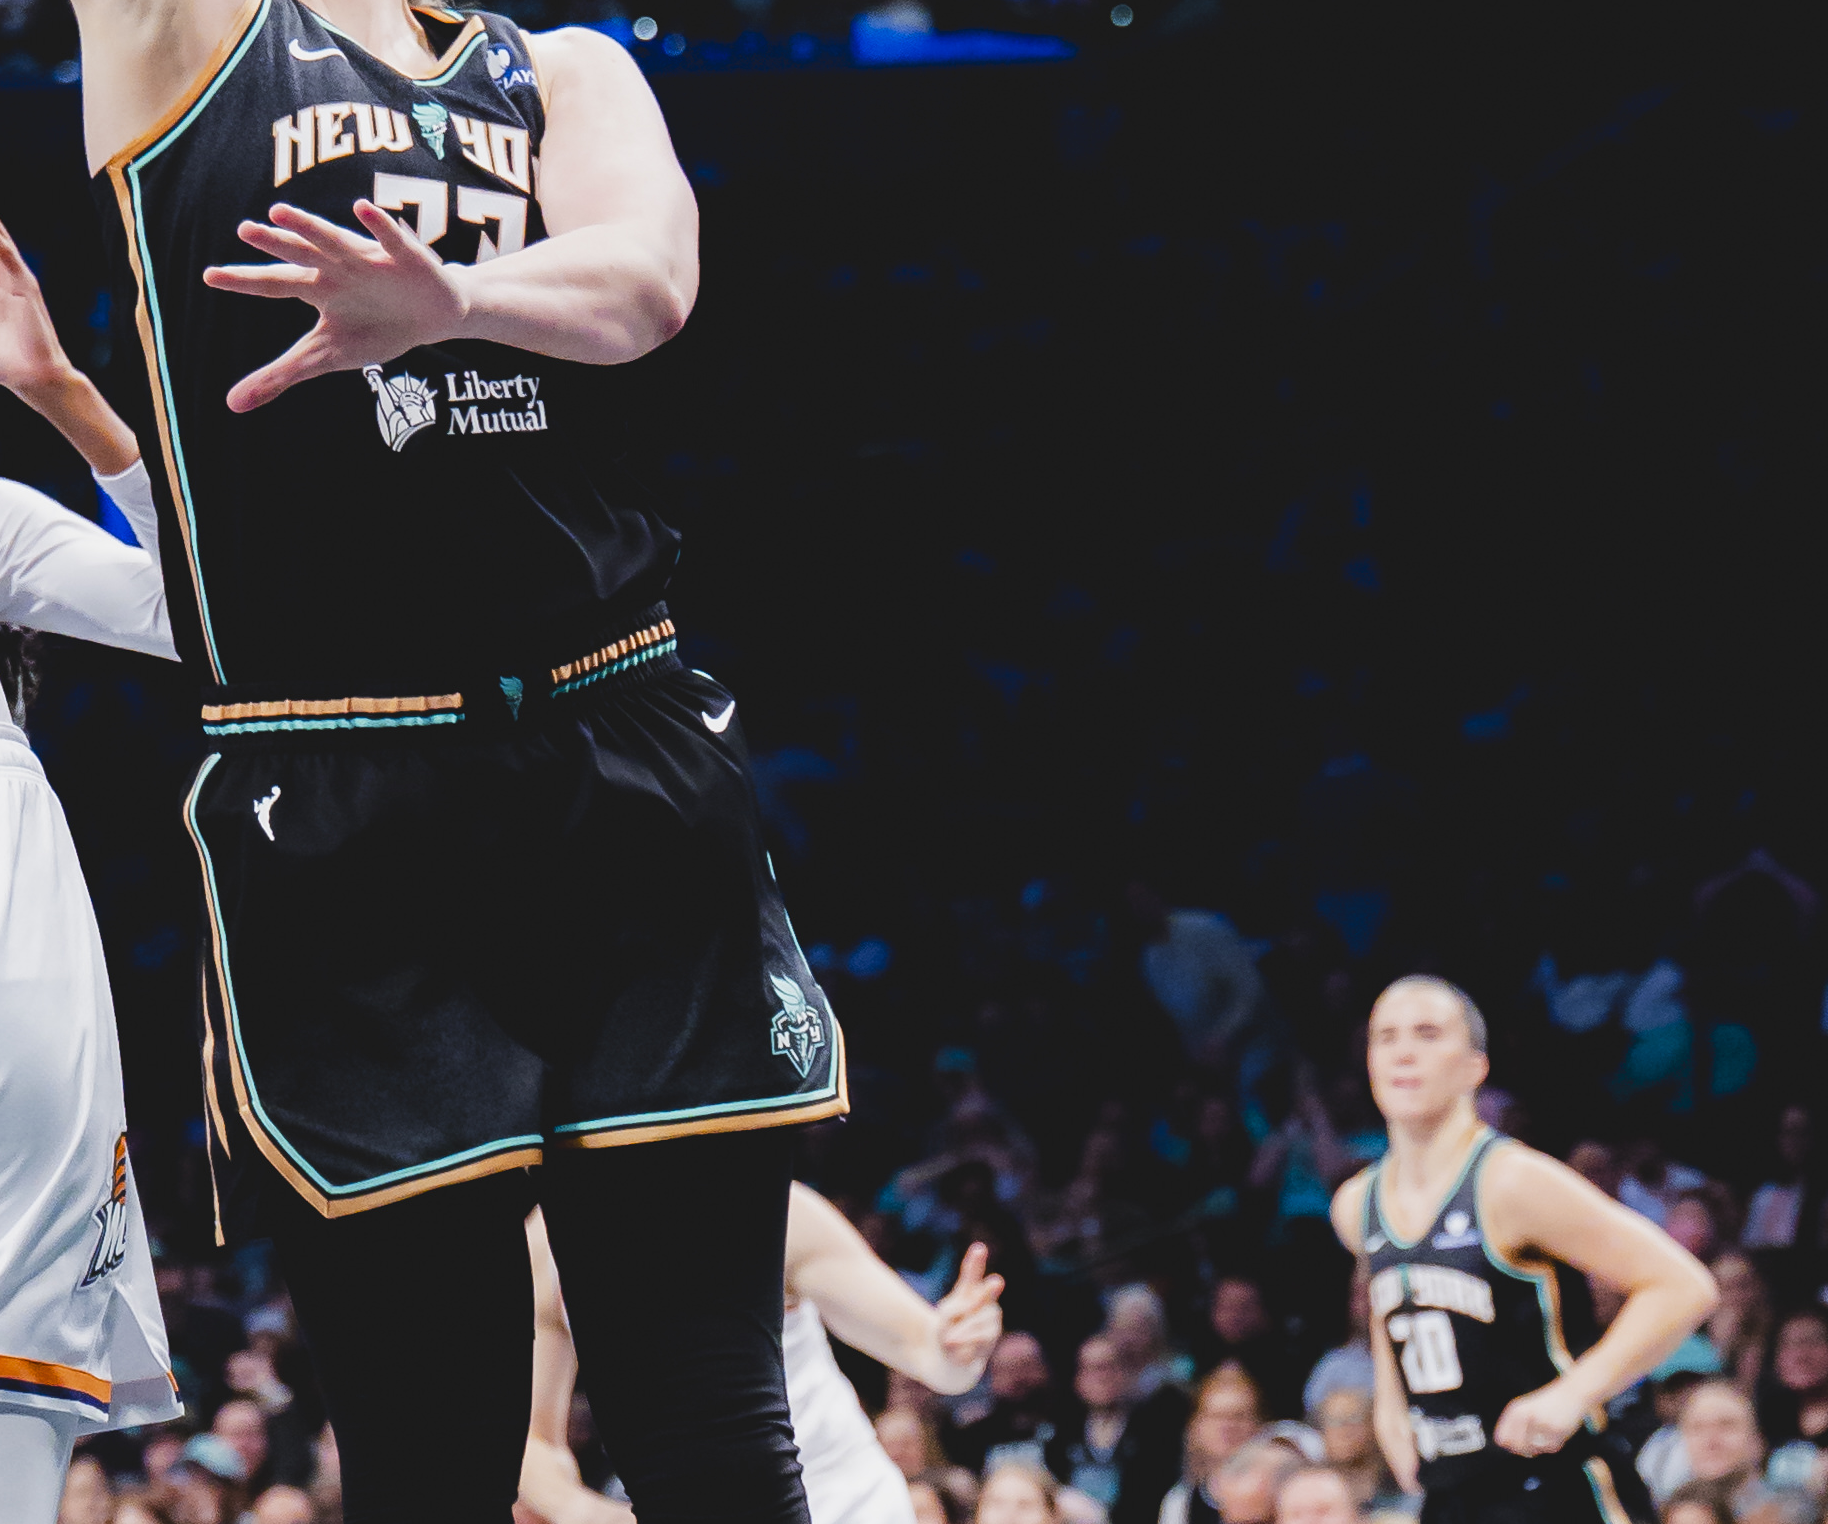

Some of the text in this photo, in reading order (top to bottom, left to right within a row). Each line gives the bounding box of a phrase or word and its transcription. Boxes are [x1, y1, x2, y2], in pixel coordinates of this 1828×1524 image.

[272, 101, 531, 194] NEW YO
[444, 370, 540, 409] Liberty
[447, 400, 548, 435] Mutual
